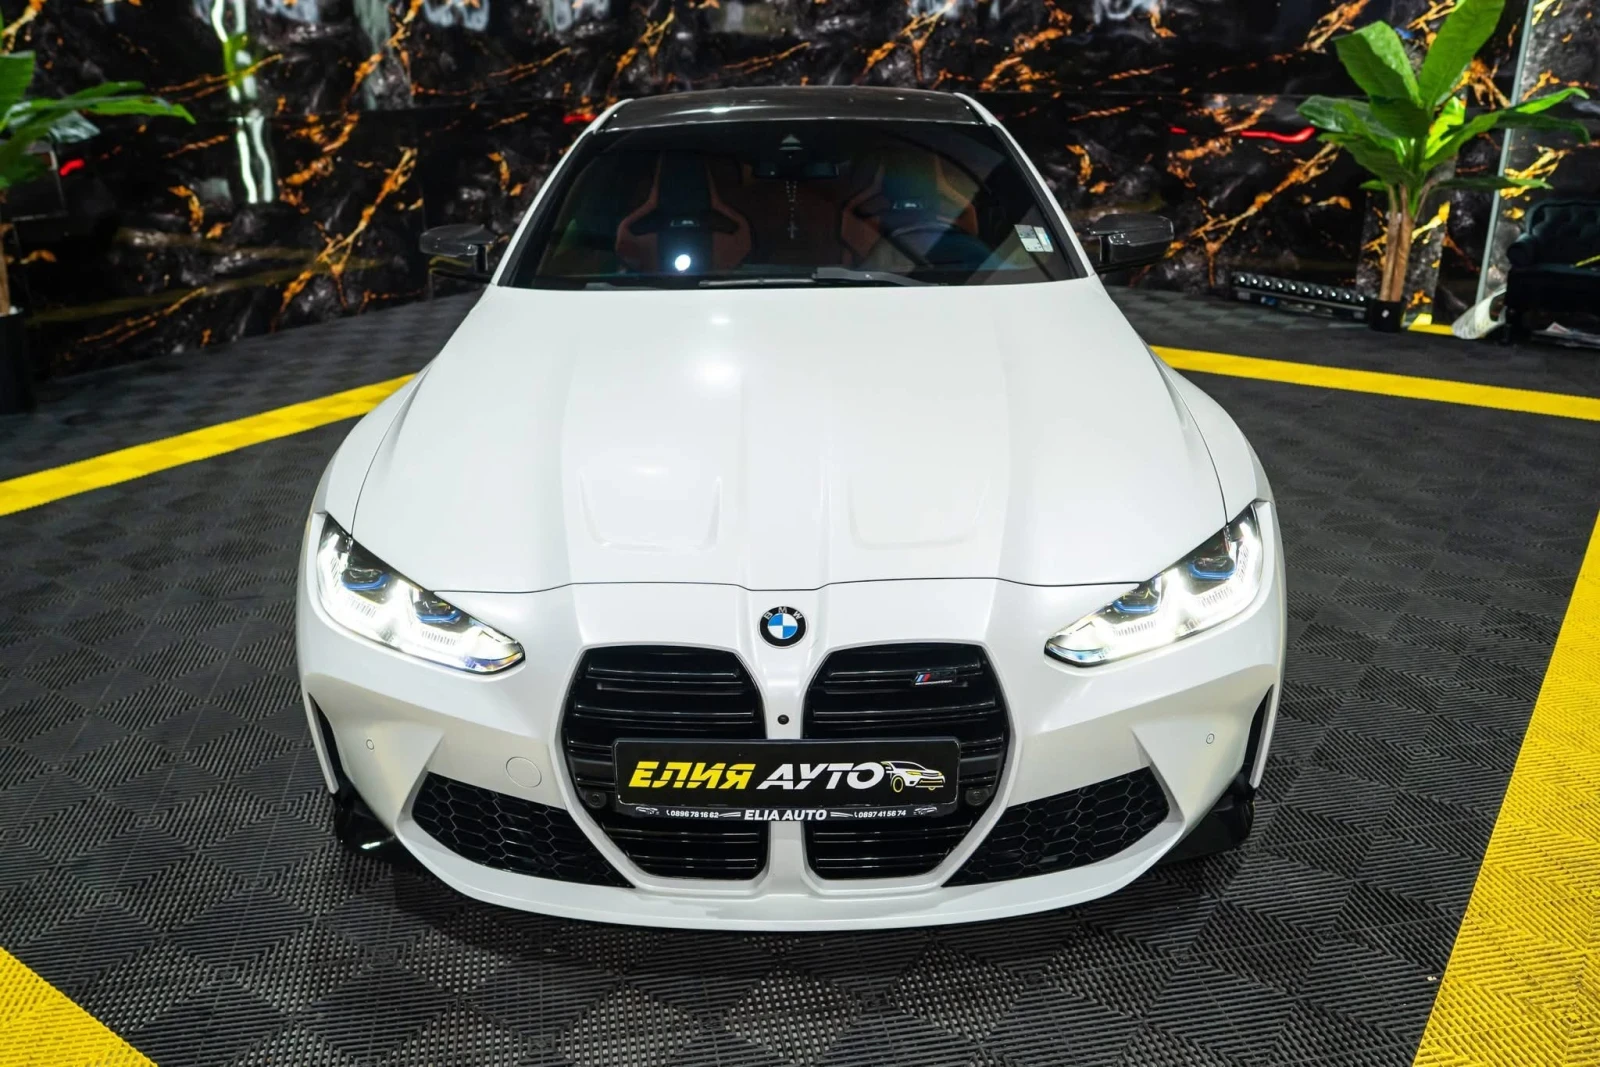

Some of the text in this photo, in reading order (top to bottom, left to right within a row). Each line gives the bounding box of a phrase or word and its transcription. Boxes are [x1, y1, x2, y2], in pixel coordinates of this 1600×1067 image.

[763, 606, 803, 620] BMW
[628, 761, 885, 790] ЕЛИЯ АУТО
[744, 809, 827, 821] ELIA AUTO
